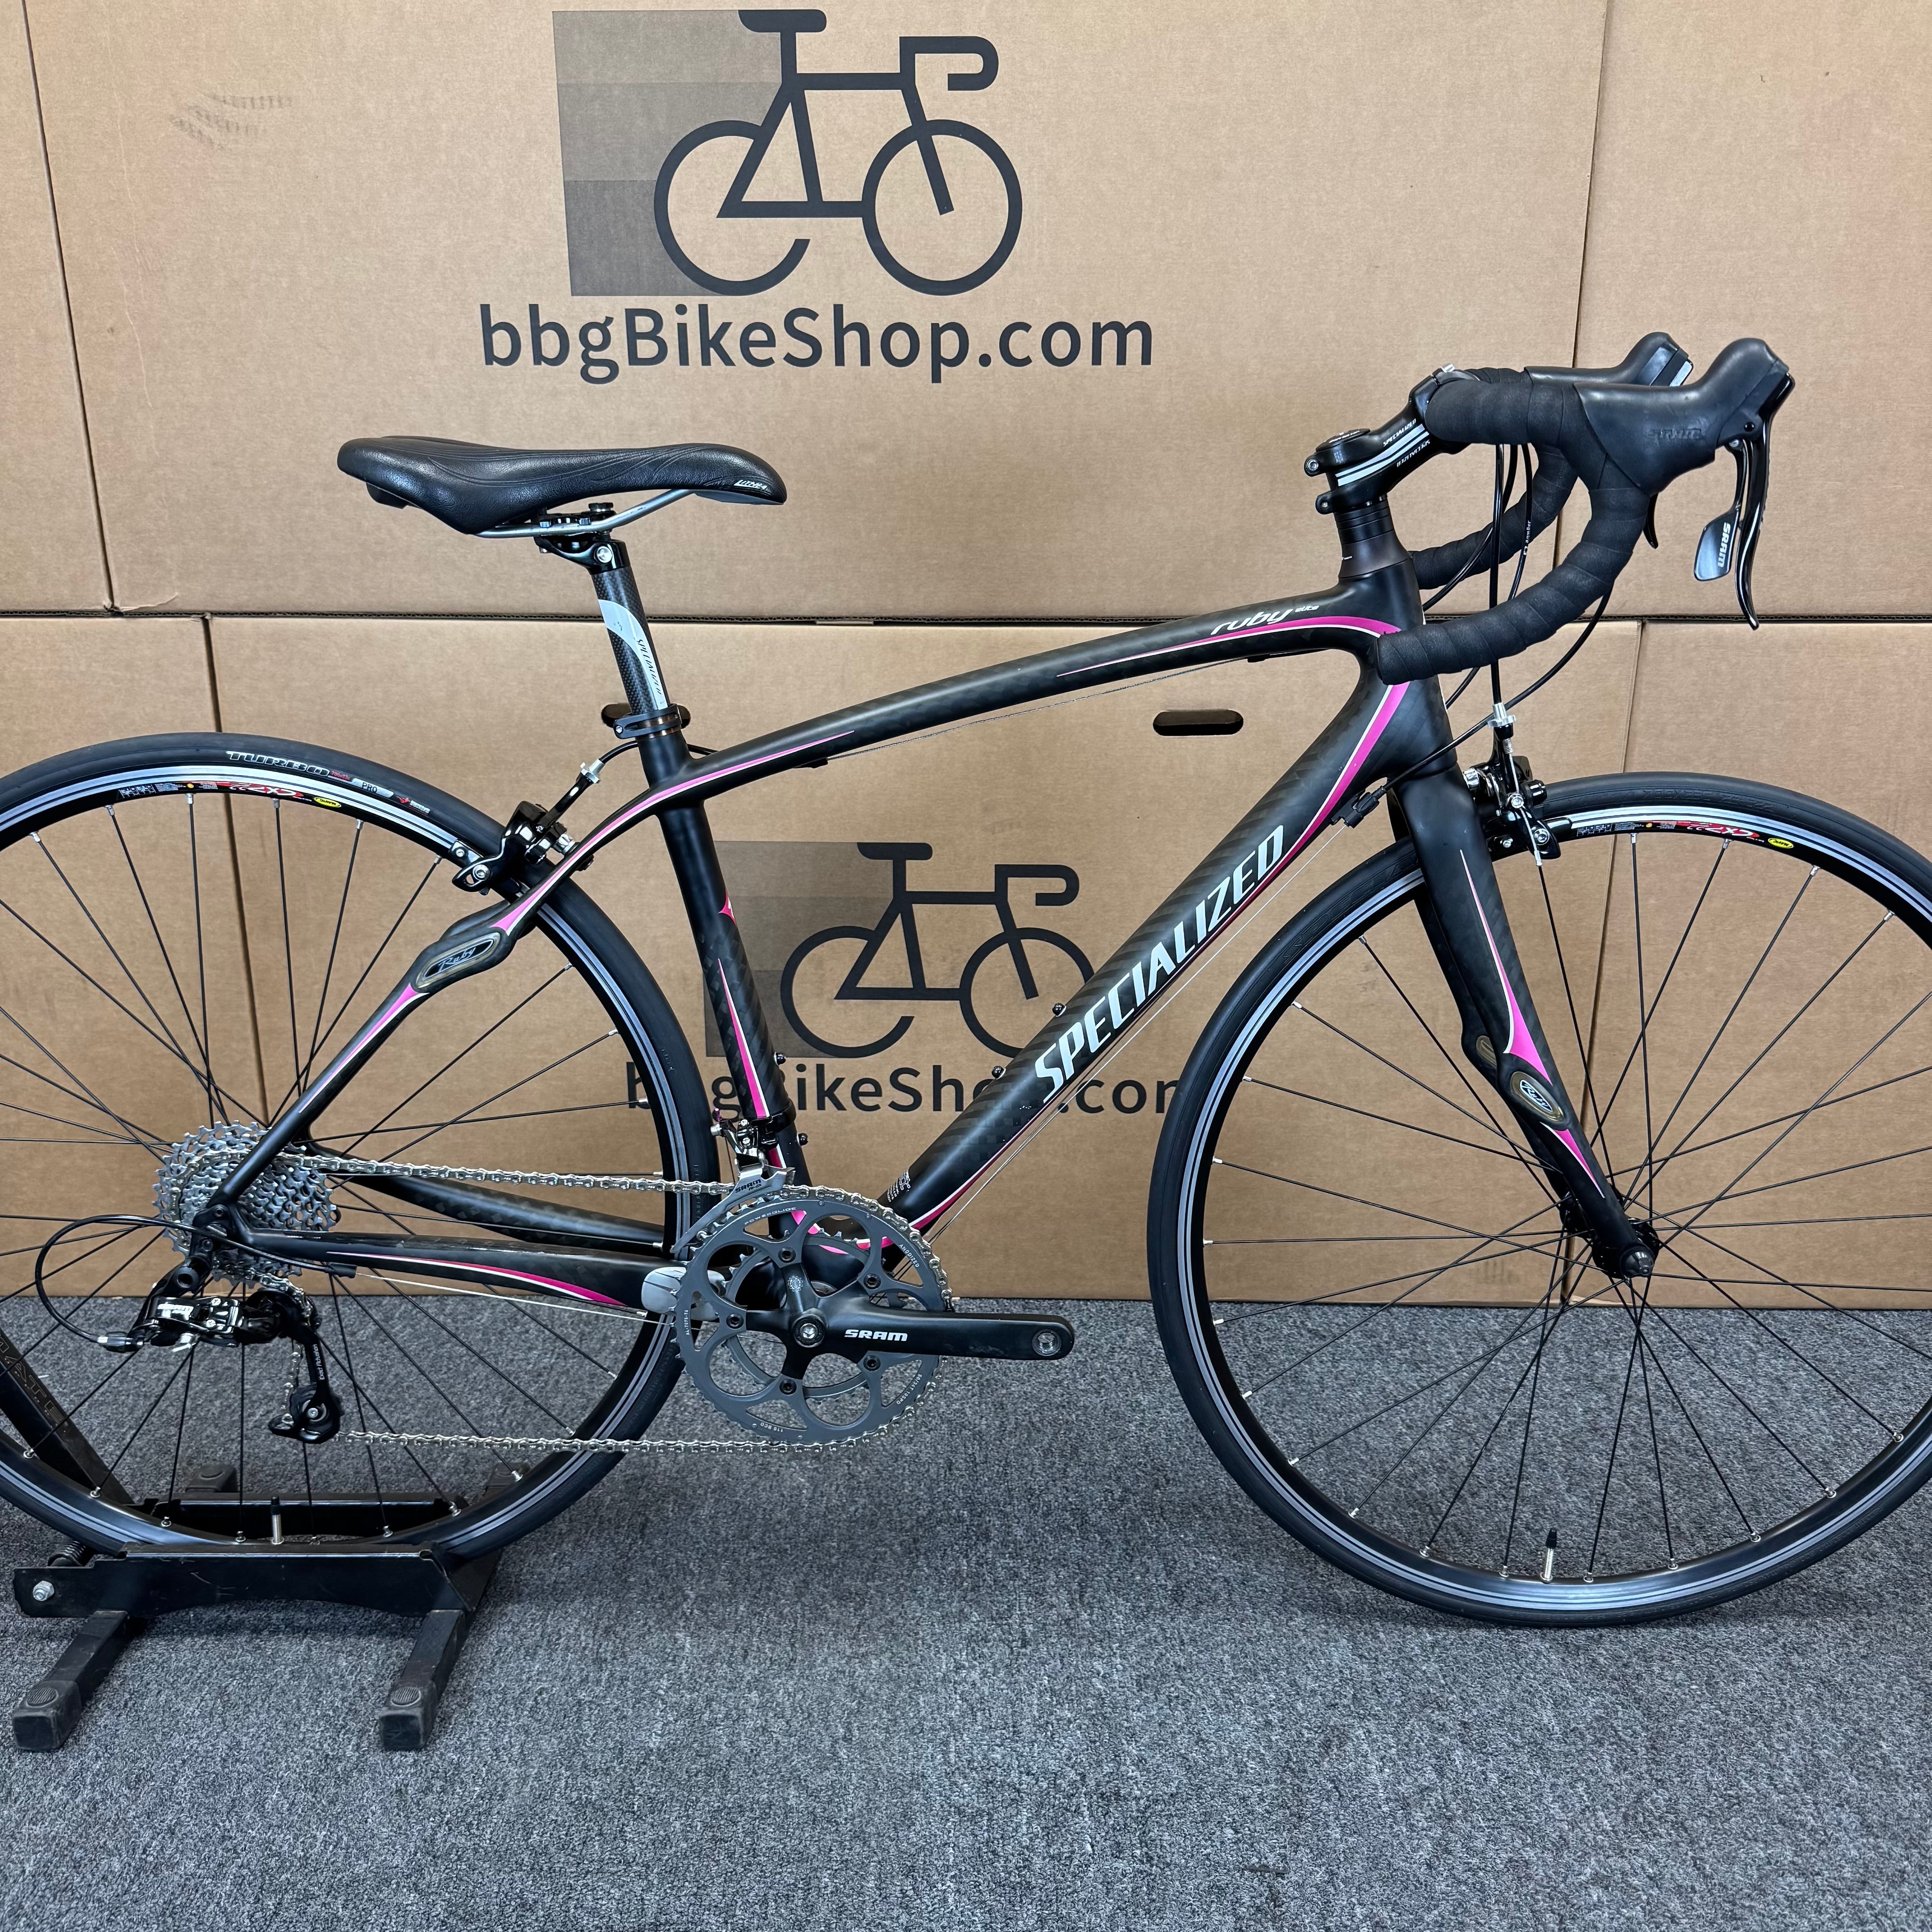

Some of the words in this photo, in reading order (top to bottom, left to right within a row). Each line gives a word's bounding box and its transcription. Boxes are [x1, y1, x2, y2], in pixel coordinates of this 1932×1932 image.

[479, 304, 1153, 384] bbgBikeShop.com
[1383, 418, 1417, 447] SPECIALIZED
[1717, 522, 1731, 568] SRAM
[1210, 608, 1294, 635] ruby
[225, 750, 330, 777] TURBO
[362, 782, 378, 793] PRO
[438, 947, 476, 972] Ruby
[1035, 825, 1284, 1104] SPECIALIZED
[735, 1179, 762, 1193] SRAM
[744, 1207, 796, 1225] POWERGLIDE
[899, 1244, 920, 1267] ANODIZED
[844, 1329, 908, 1342] SRAM
[896, 1391, 911, 1405] 10SPD
